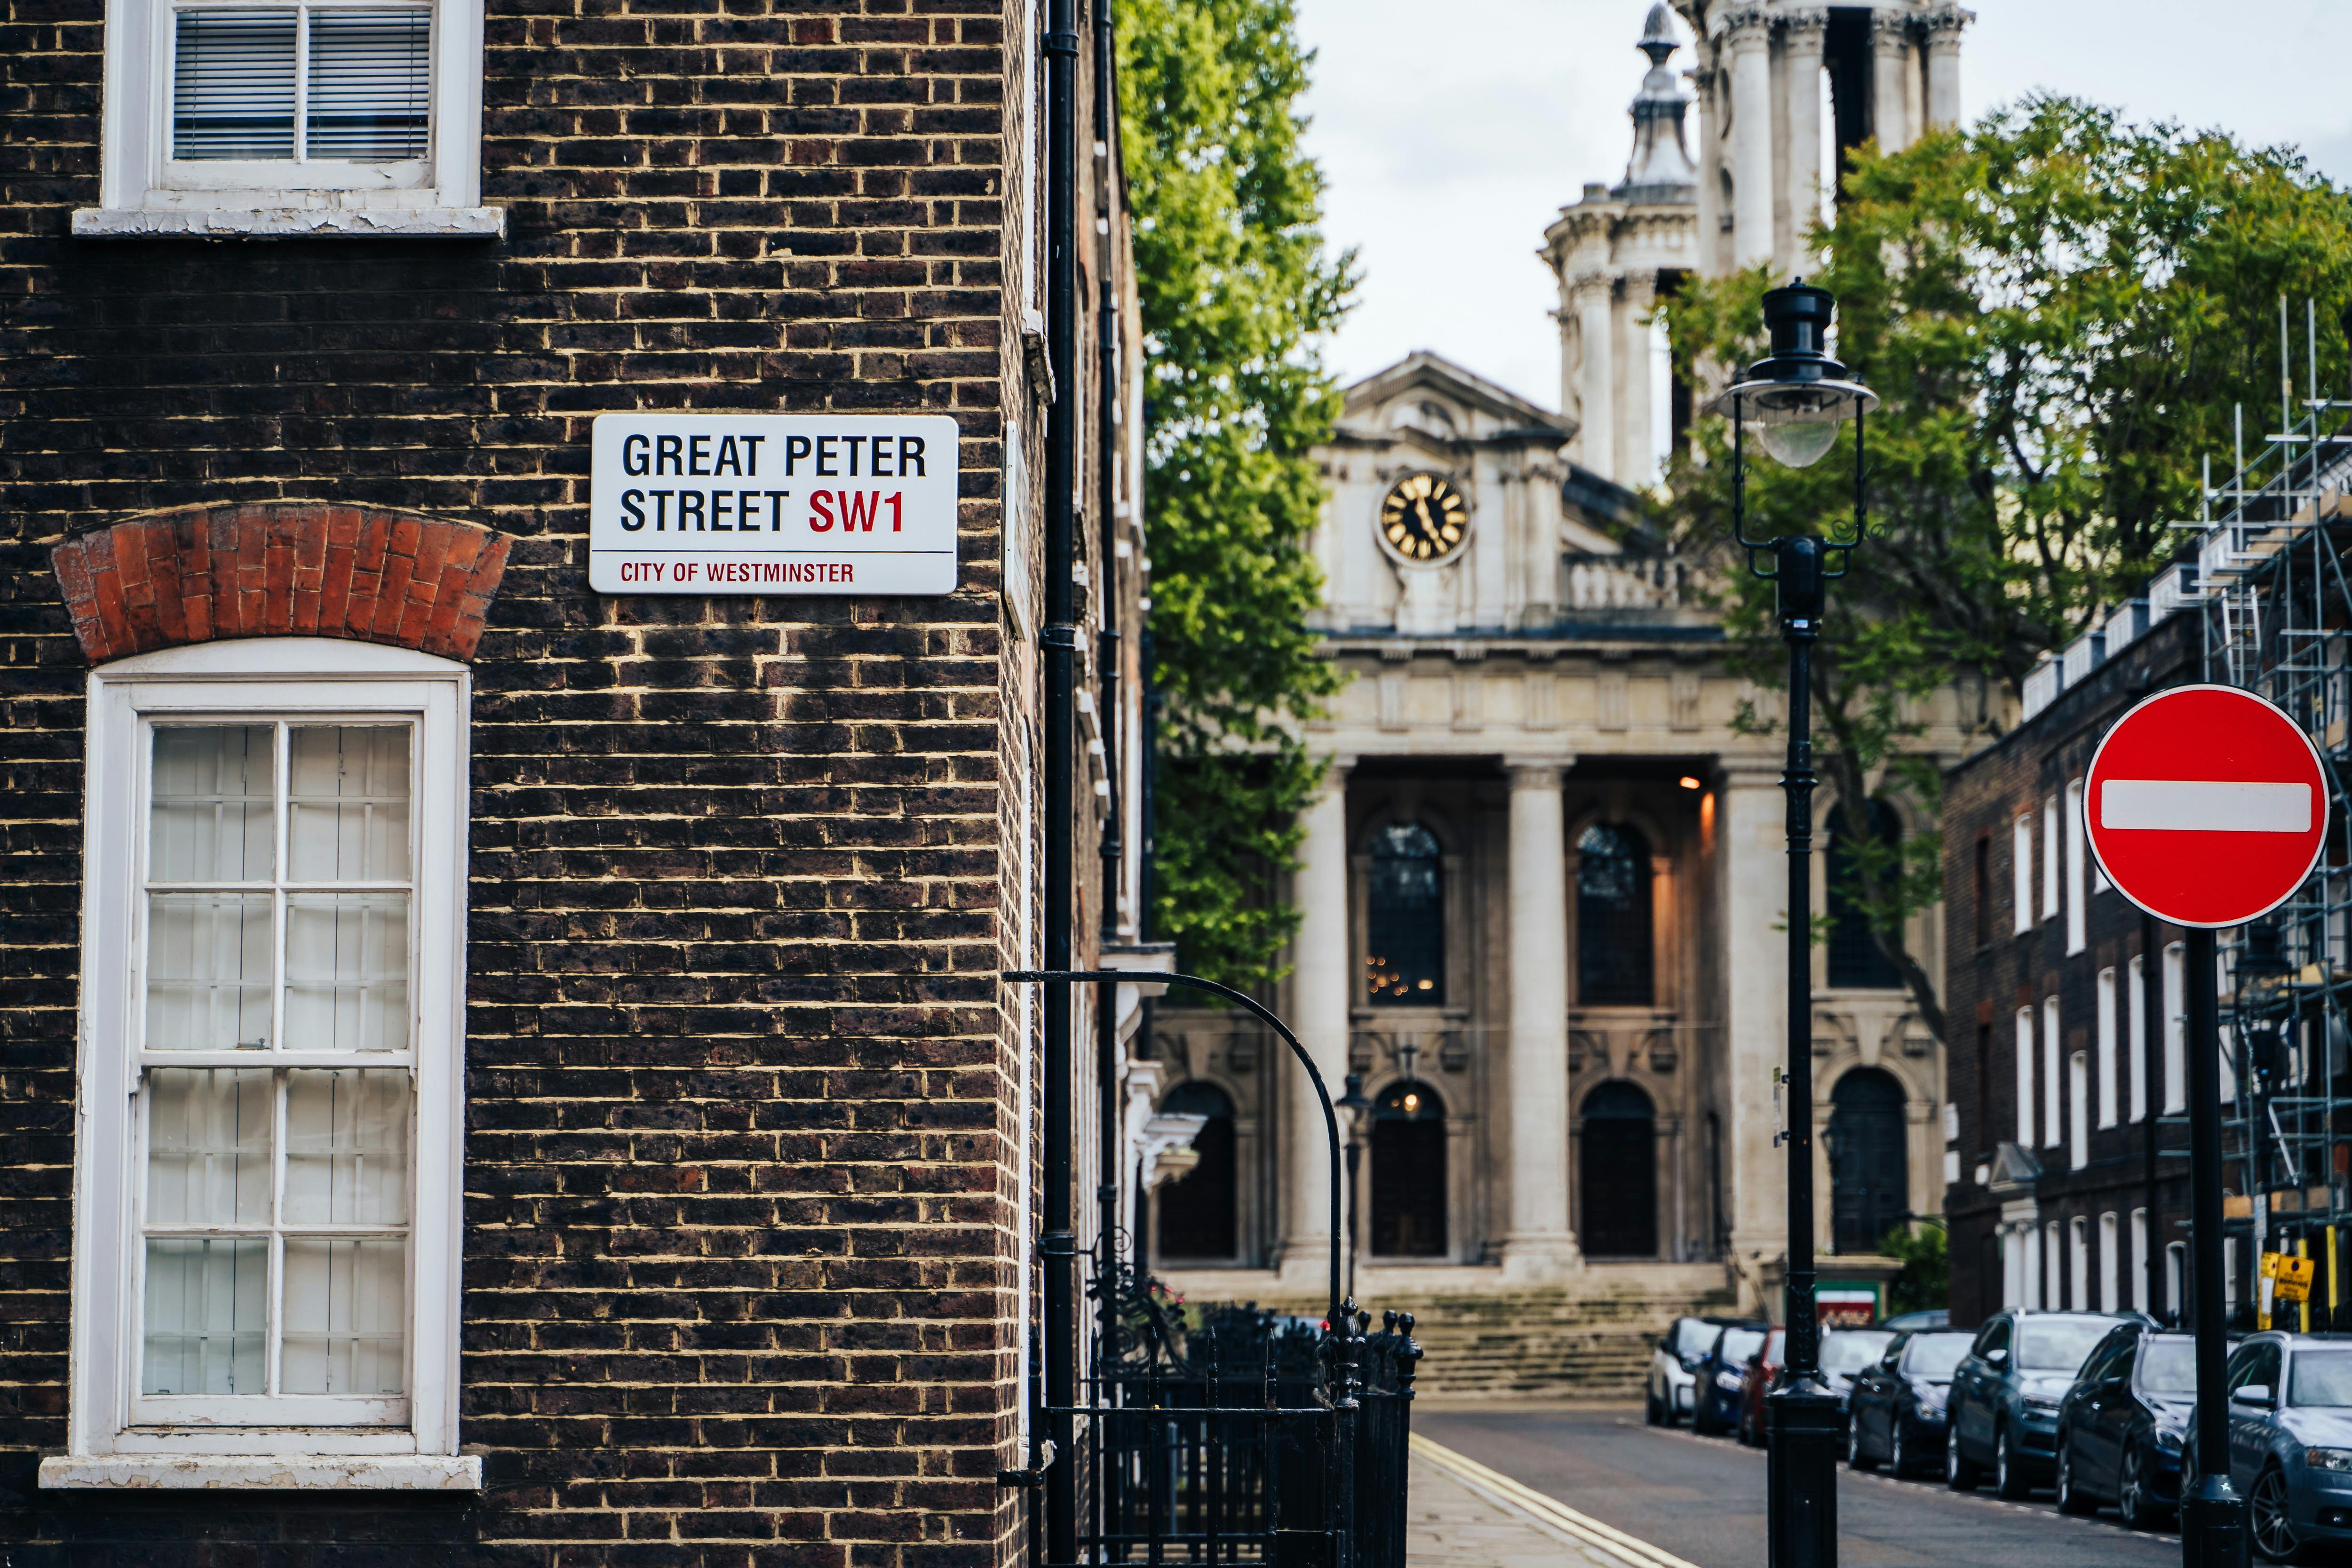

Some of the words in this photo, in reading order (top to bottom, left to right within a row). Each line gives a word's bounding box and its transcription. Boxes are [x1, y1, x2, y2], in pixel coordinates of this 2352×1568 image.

[623, 434, 765, 476] GREAT
[786, 436, 926, 477] PETER
[620, 489, 789, 531] STREET
[810, 490, 901, 532] SW1
[621, 563, 665, 581] CITY
[674, 563, 698, 581] OF
[707, 564, 853, 582] WESTMINSTER
